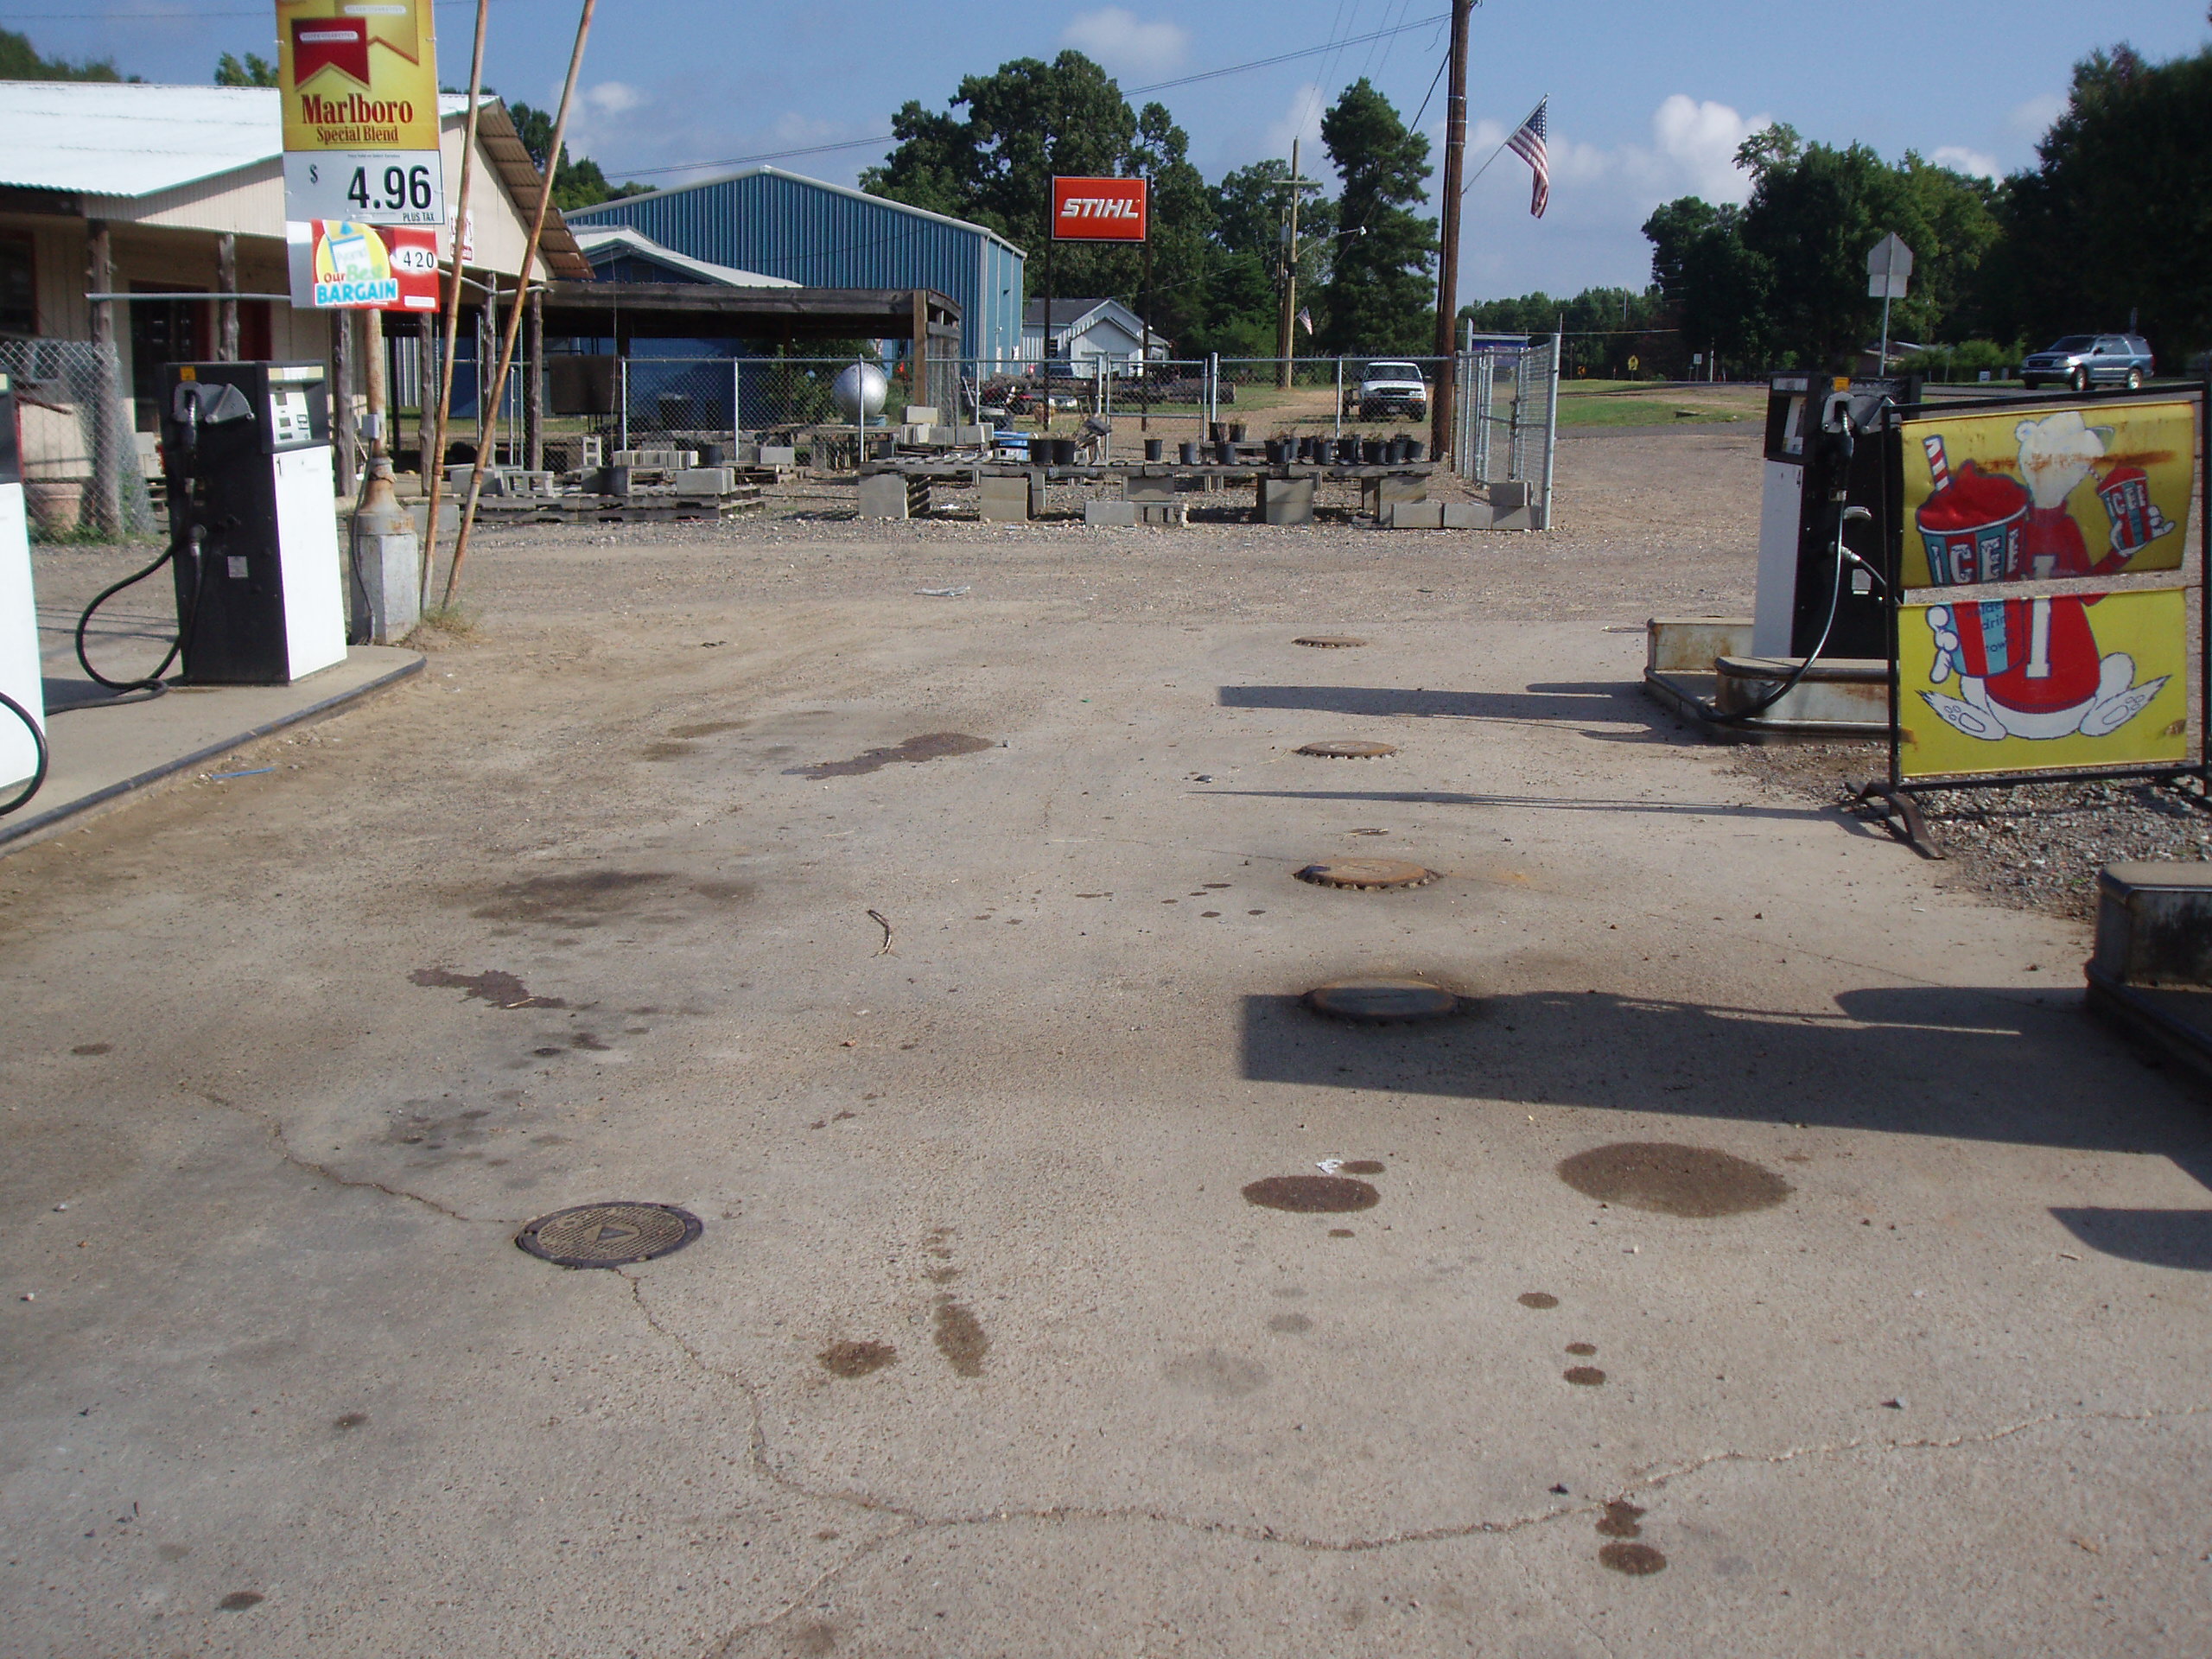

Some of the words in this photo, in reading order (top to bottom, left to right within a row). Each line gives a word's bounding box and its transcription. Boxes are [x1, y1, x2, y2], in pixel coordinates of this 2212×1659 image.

[301, 92, 413, 124] Marlboro
[317, 125, 360, 145] Special
[363, 125, 398, 143] Blend
[347, 164, 432, 210] 4.96
[403, 213, 420, 222] PLUS
[421, 213, 435, 222] TAX
[1060, 198, 1139, 219] STIHL
[323, 272, 346, 283] Our
[346, 264, 384, 283] Best
[316, 279, 397, 305] BARGAIN
[2106, 485, 2146, 517] ICEE
[1931, 528, 2019, 583] ICEE
